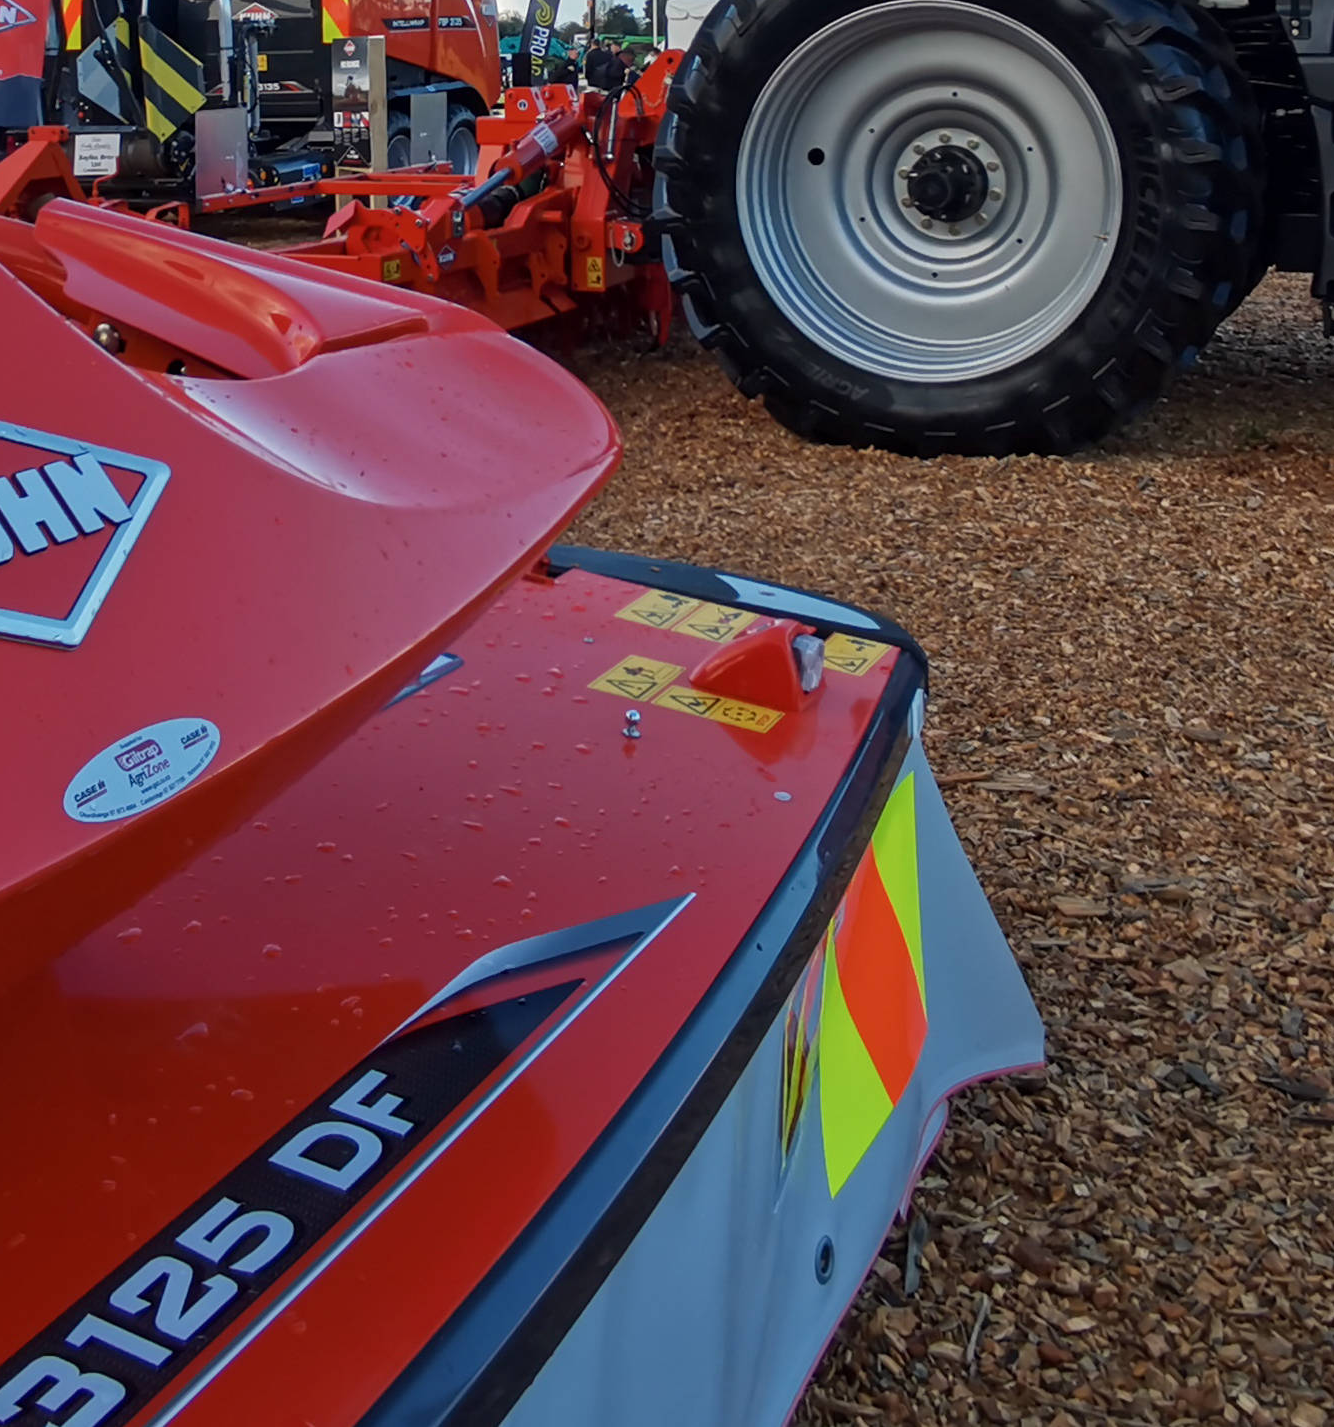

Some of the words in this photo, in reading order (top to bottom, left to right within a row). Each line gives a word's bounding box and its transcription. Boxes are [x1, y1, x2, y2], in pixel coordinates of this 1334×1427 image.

[180, 728, 201, 744] CASE
[123, 743, 161, 769] Giltrap
[128, 758, 171, 788] AgriZone
[74, 784, 98, 802] CASE
[267, 1068, 415, 1193] DF
